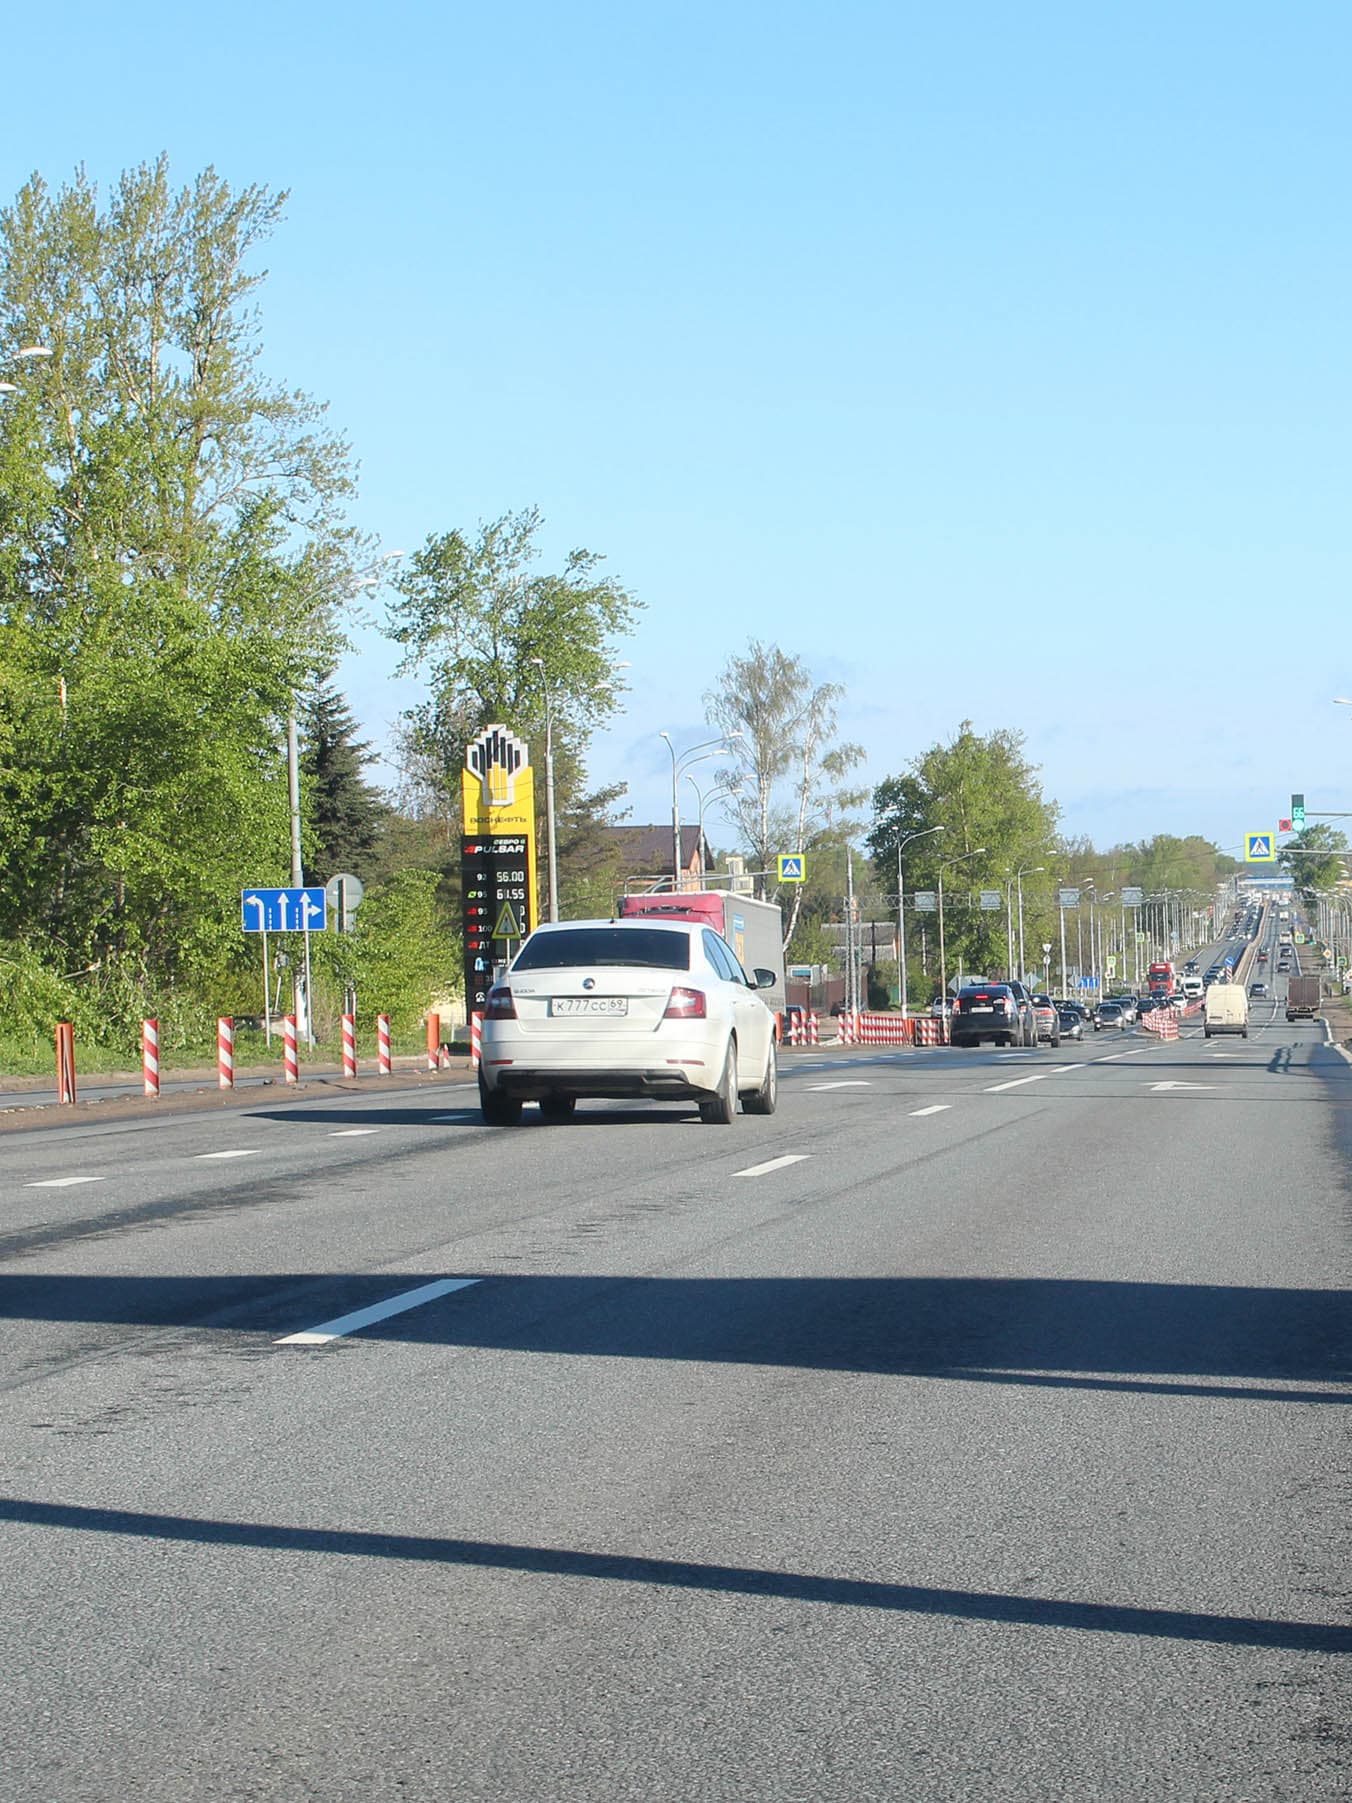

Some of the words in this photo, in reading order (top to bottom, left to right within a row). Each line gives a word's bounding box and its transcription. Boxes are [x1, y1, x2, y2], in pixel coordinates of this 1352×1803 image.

[474, 845, 525, 854] PULSAR
[496, 871, 525, 882] 56.00
[610, 1000, 622, 1008] 69
